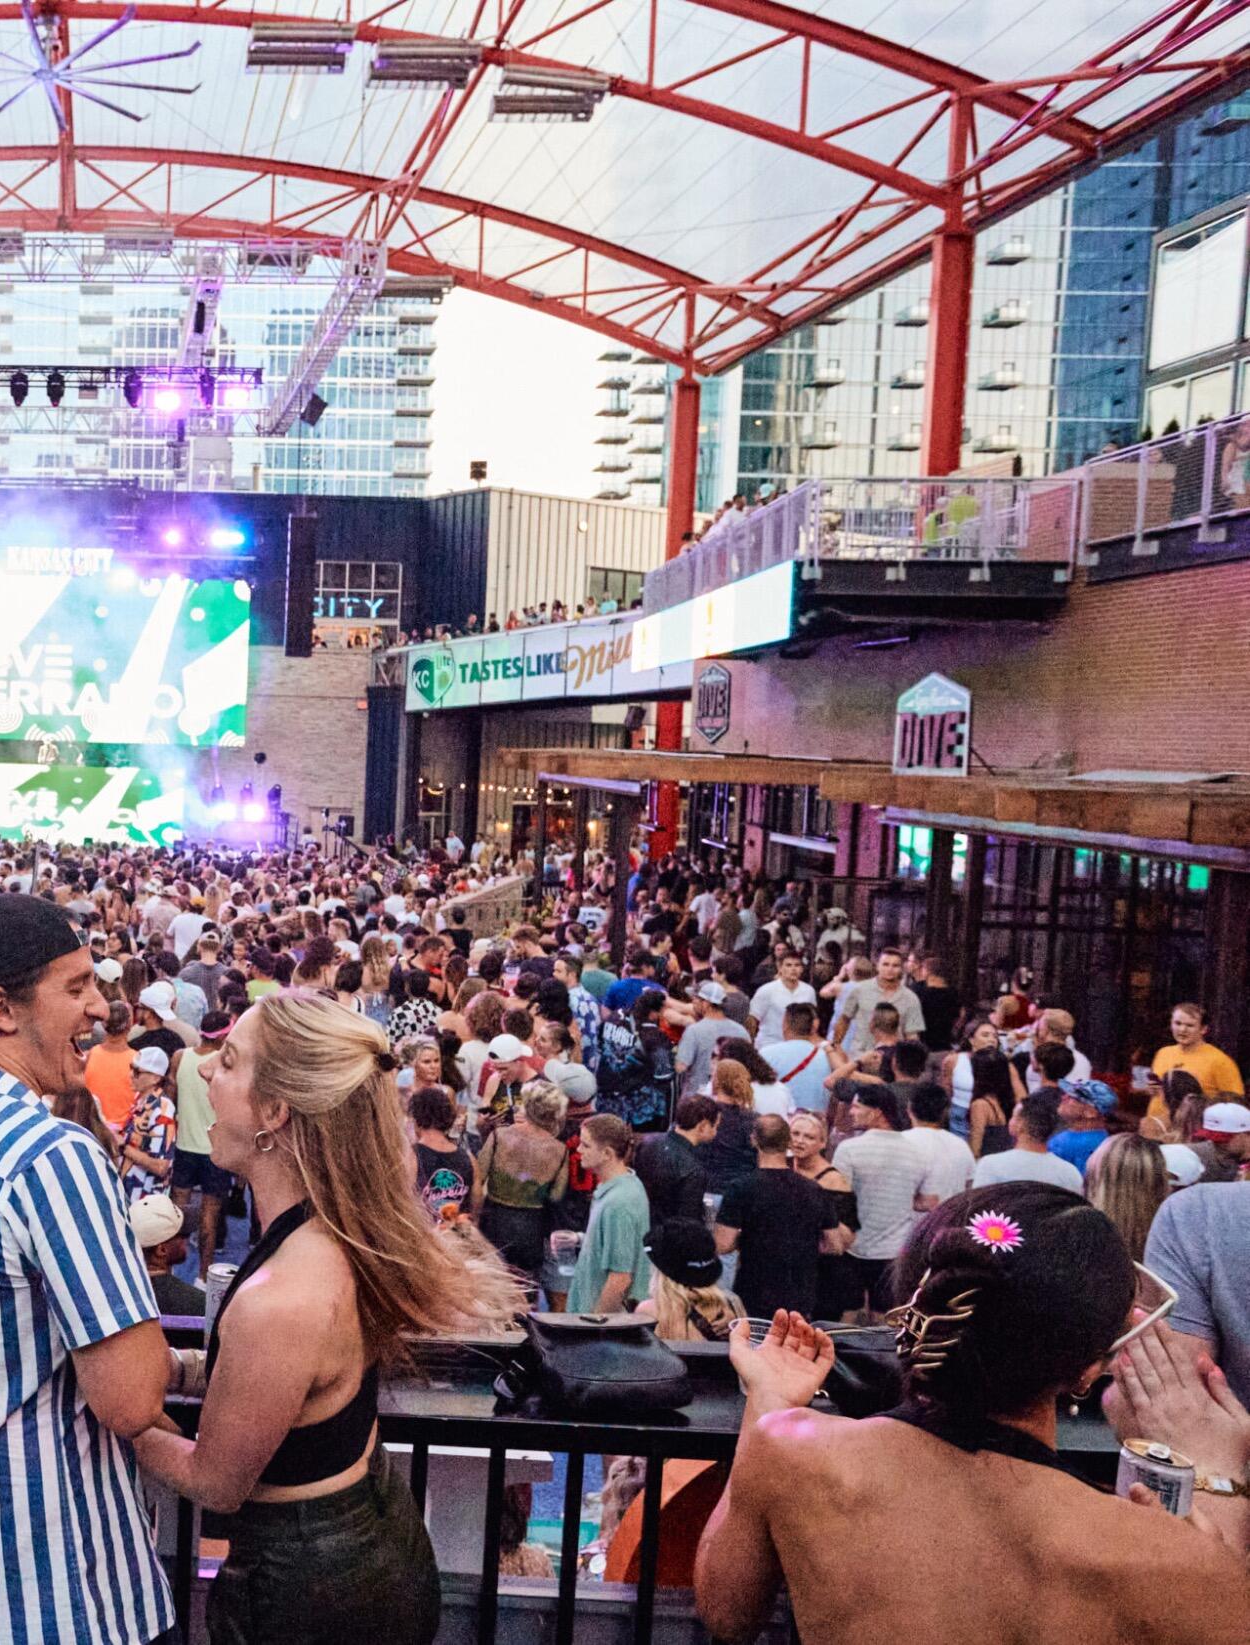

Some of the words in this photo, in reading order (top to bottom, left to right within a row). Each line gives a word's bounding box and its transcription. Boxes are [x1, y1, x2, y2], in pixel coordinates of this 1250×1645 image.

[411, 670, 430, 689] KC
[459, 656, 524, 684] TASTES
[526, 651, 566, 677] LIKE
[561, 631, 633, 690] Mill
